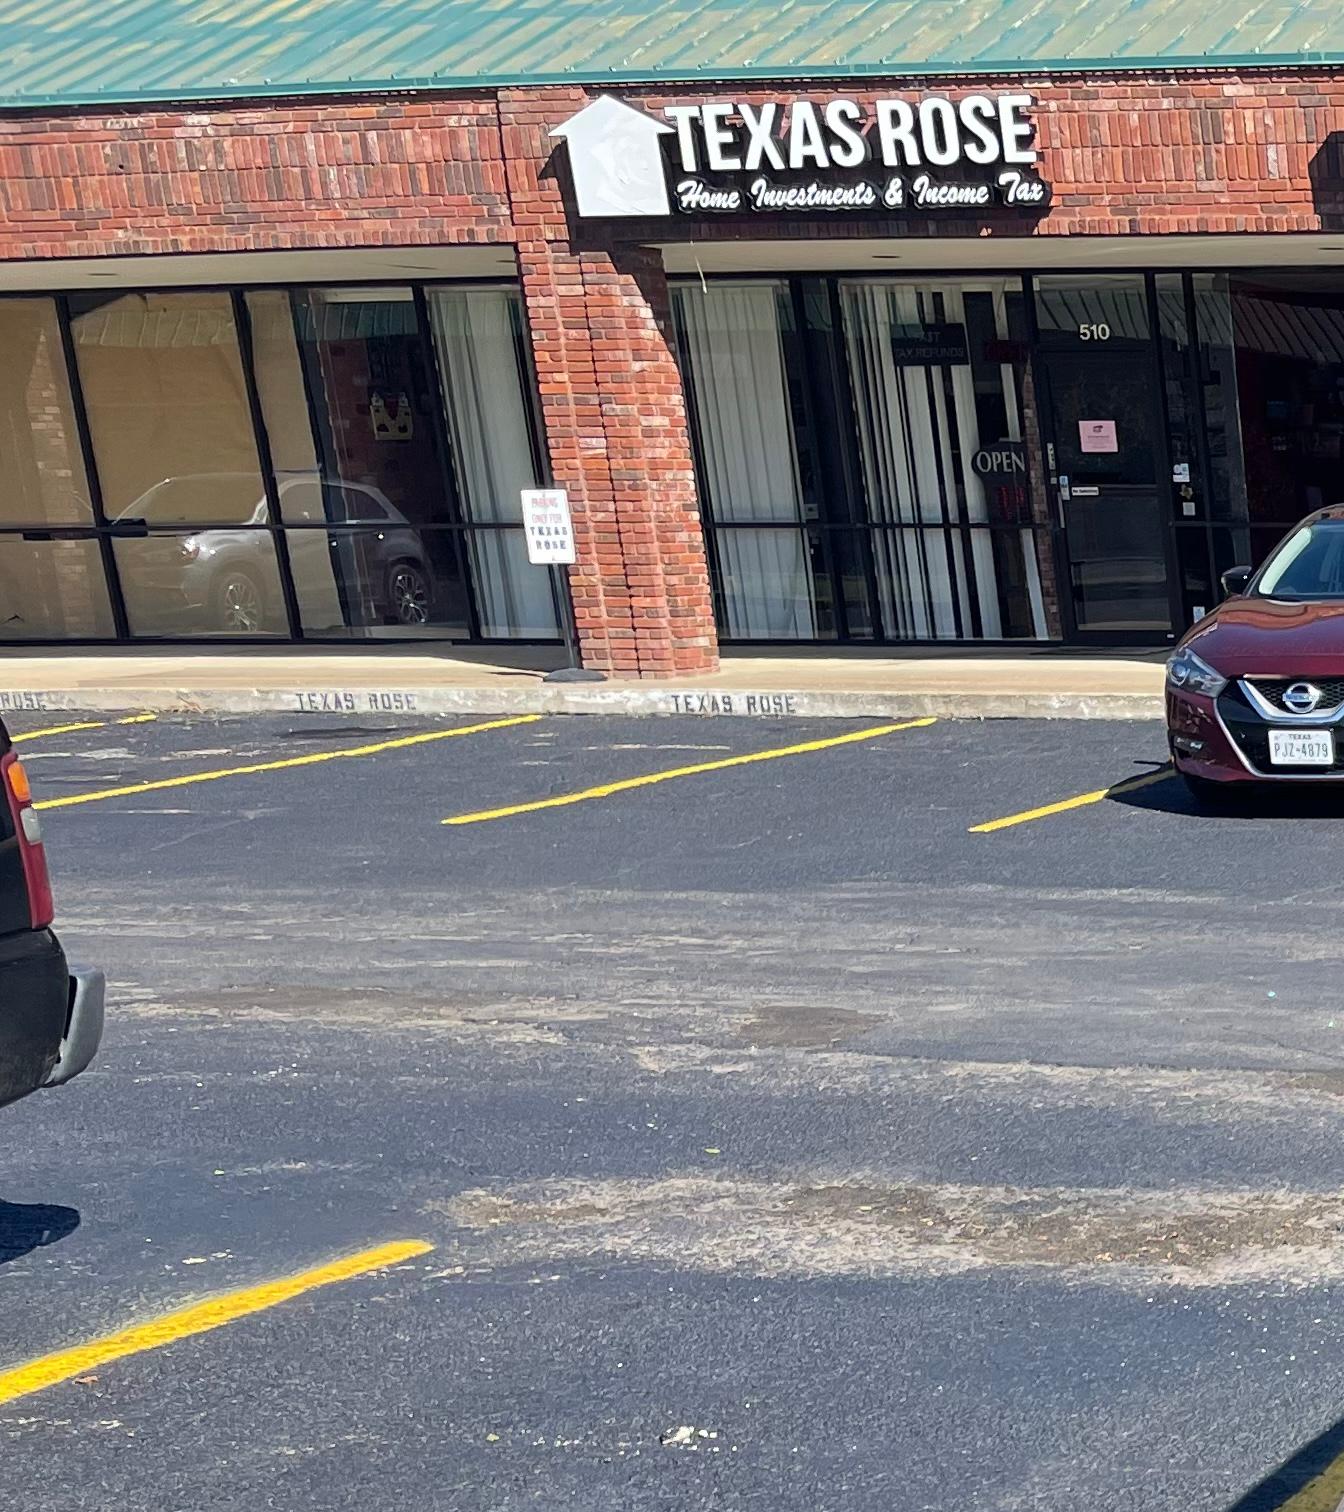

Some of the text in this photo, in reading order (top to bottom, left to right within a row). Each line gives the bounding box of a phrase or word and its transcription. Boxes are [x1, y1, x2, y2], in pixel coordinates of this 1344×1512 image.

[664, 95, 1038, 172] TEXAS ROSE
[677, 172, 1043, 208] Home Investments & Income Tax
[1079, 324, 1110, 340] 510
[976, 450, 1026, 473] OPEN
[530, 526, 567, 536] TEXAS
[536, 540, 567, 550] ROSE
[295, 693, 416, 711] TEXAS ROSE
[671, 694, 796, 713] TEXAS ROSE
